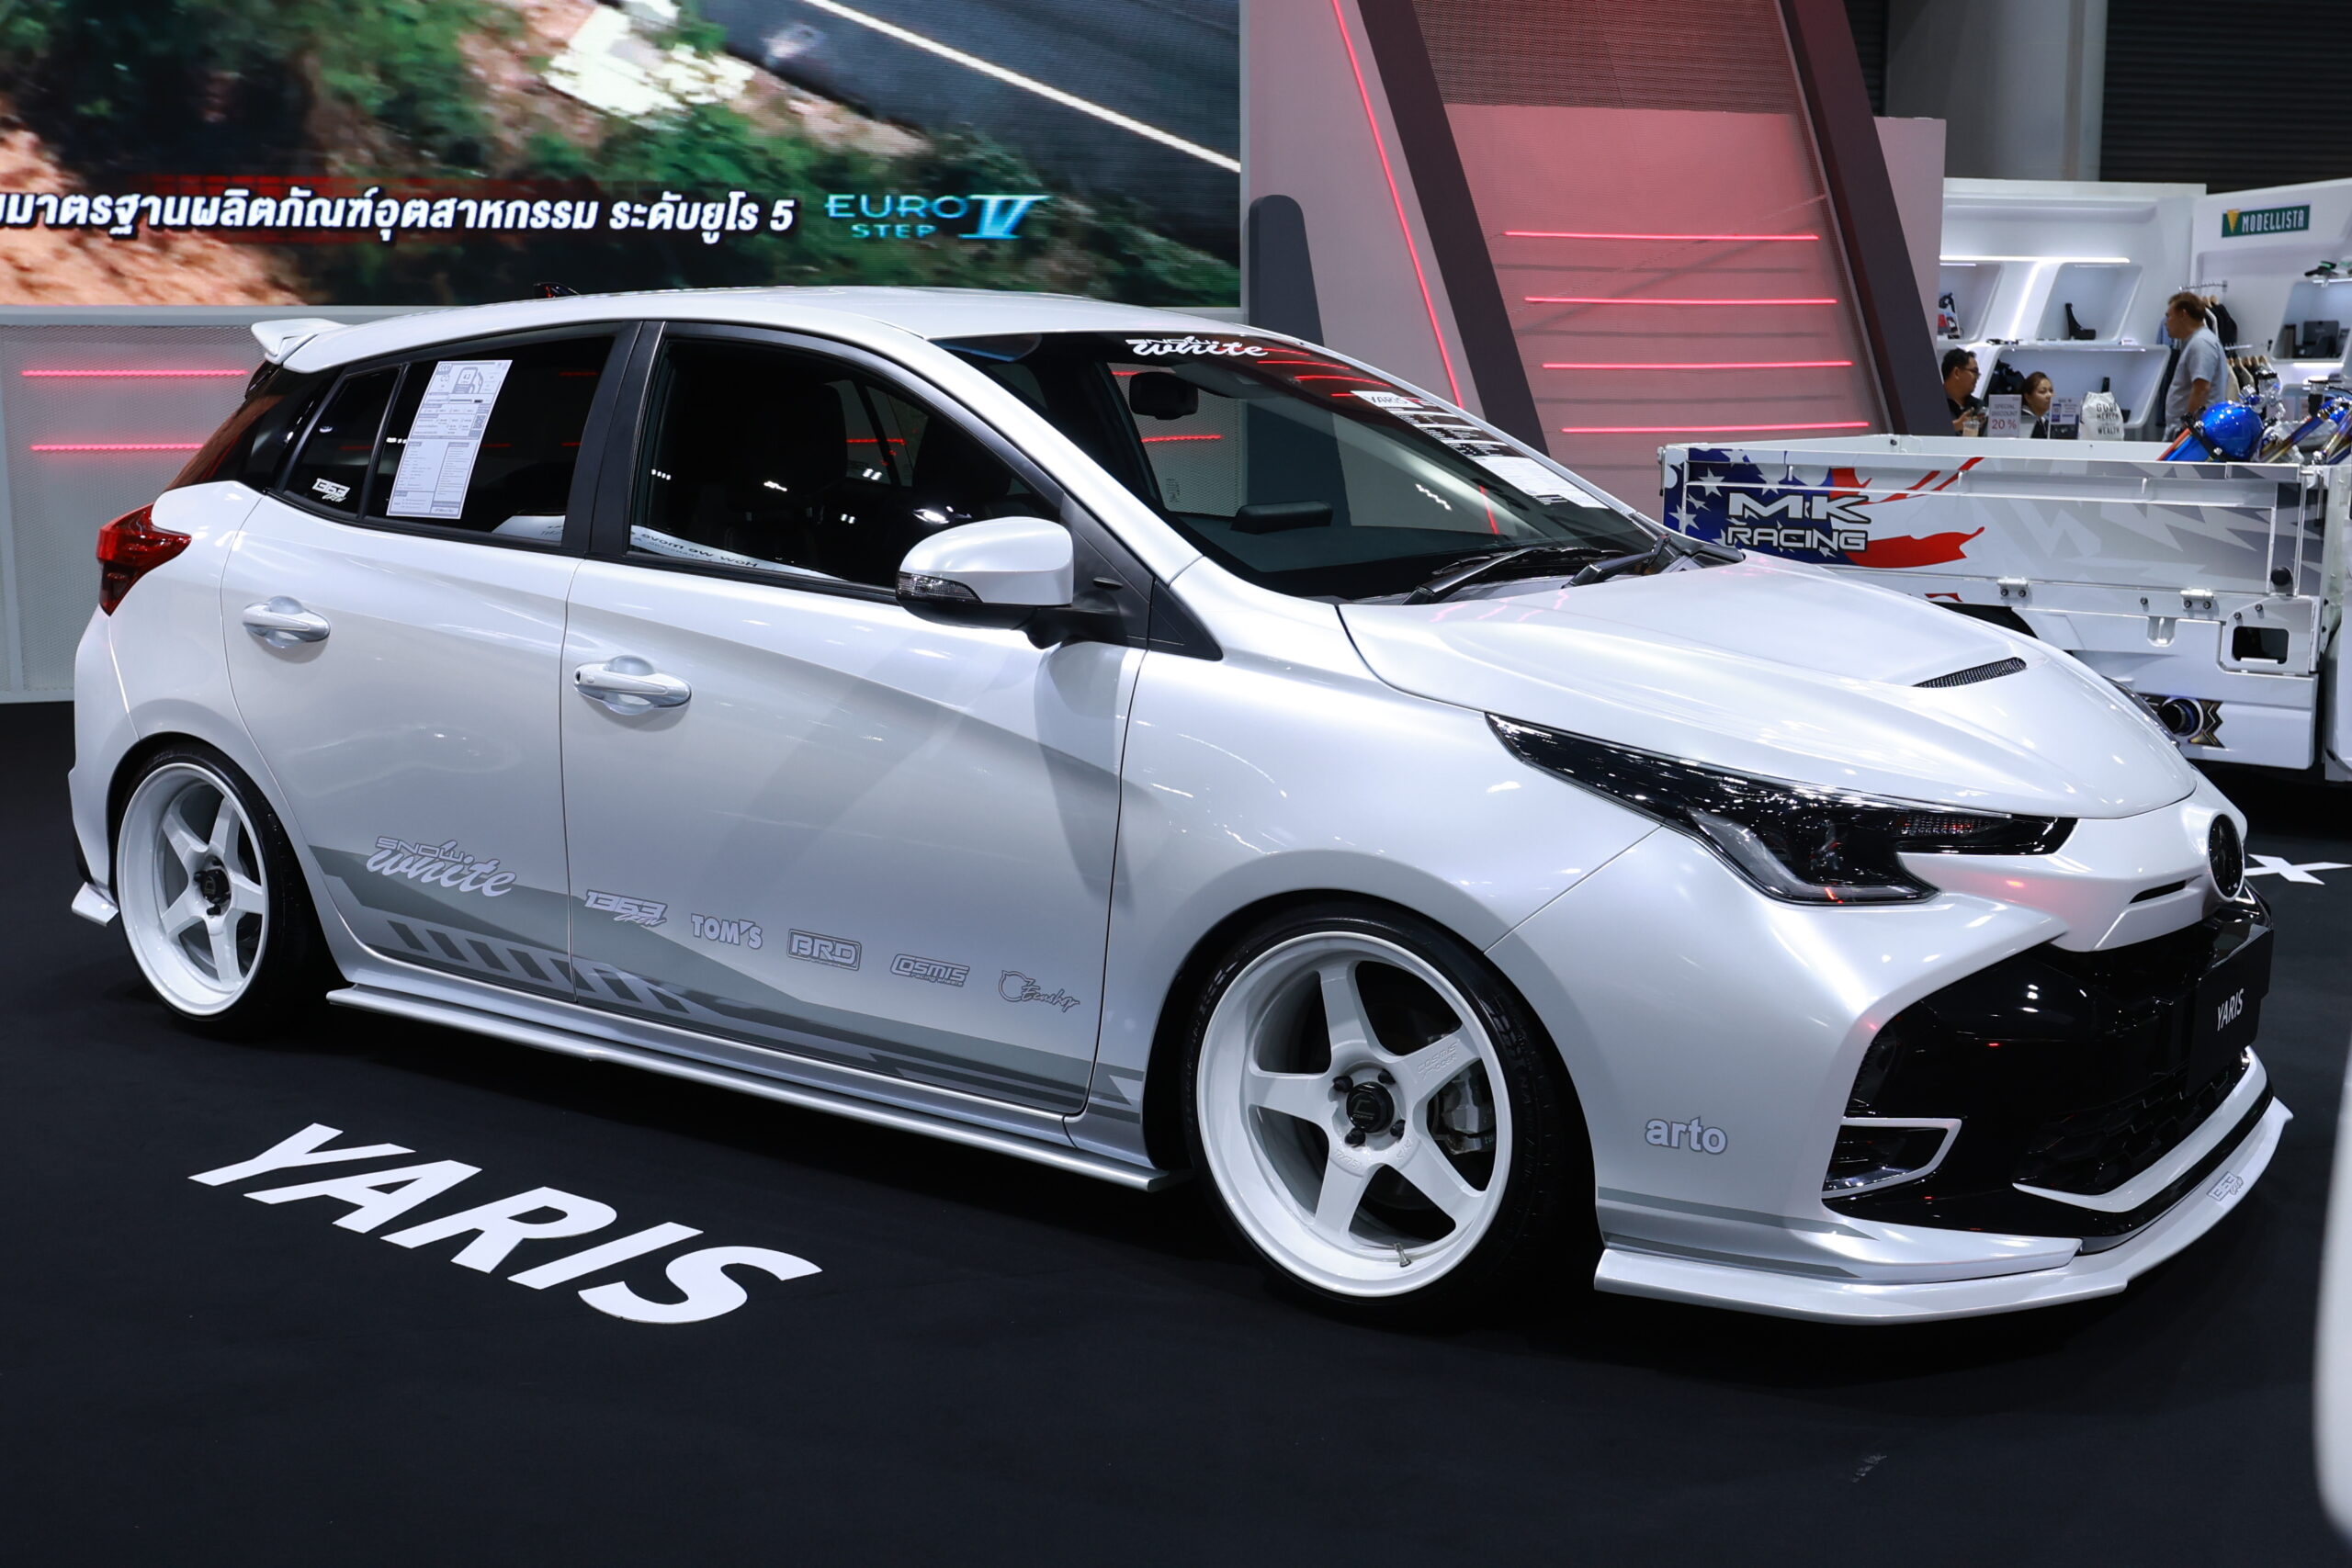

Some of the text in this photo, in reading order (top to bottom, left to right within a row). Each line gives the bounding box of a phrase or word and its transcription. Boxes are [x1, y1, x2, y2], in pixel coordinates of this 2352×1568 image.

[0, 186, 795, 243] มาตรฐานผลิตภัณฑ์อุตสาหกรรม ระดับยูโร 5
[825, 194, 967, 219] EURO
[2242, 209, 2305, 232] MODELLISTA
[851, 223, 937, 239] STEP
[1992, 419, 2006, 430] 20
[1727, 492, 1871, 525] MK
[1726, 526, 1868, 552] RACING
[375, 836, 464, 863] SNOW
[366, 840, 517, 897] white
[690, 913, 763, 950] TOM'S
[789, 932, 858, 965] BRD
[2217, 987, 2245, 1032] YARIS
[1645, 1115, 1728, 1156] arto
[187, 1122, 823, 1325] YARIS
